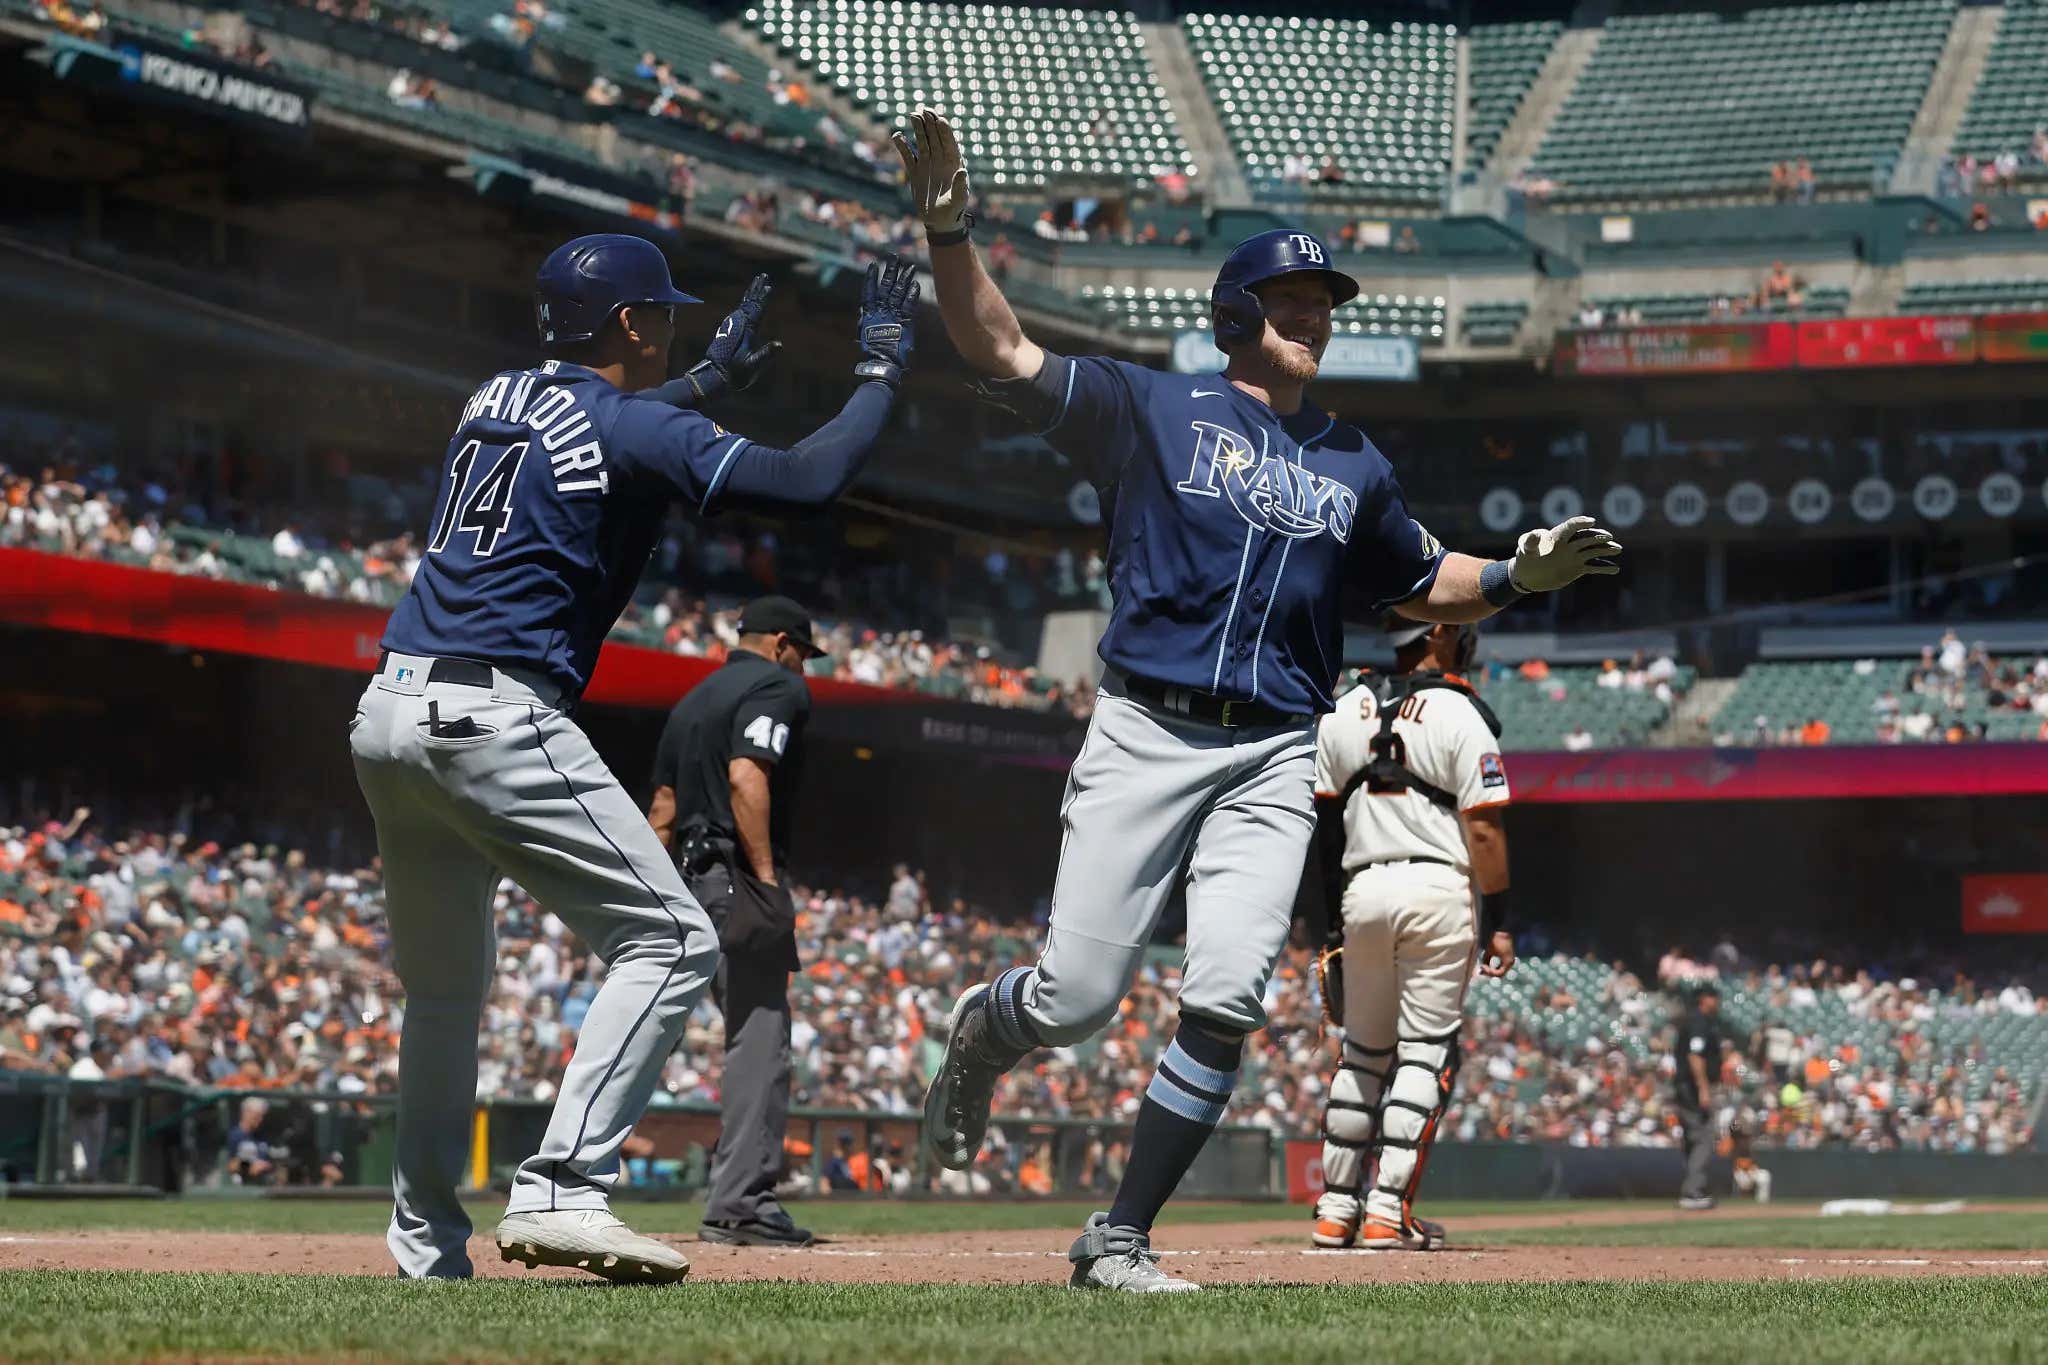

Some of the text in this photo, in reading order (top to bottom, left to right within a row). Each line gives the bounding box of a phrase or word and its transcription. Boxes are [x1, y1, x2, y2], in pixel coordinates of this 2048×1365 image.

[1289, 234, 1324, 263] TB
[427, 439, 530, 556] 14
[1360, 696, 1427, 724] SOL
[744, 715, 790, 757] 40
